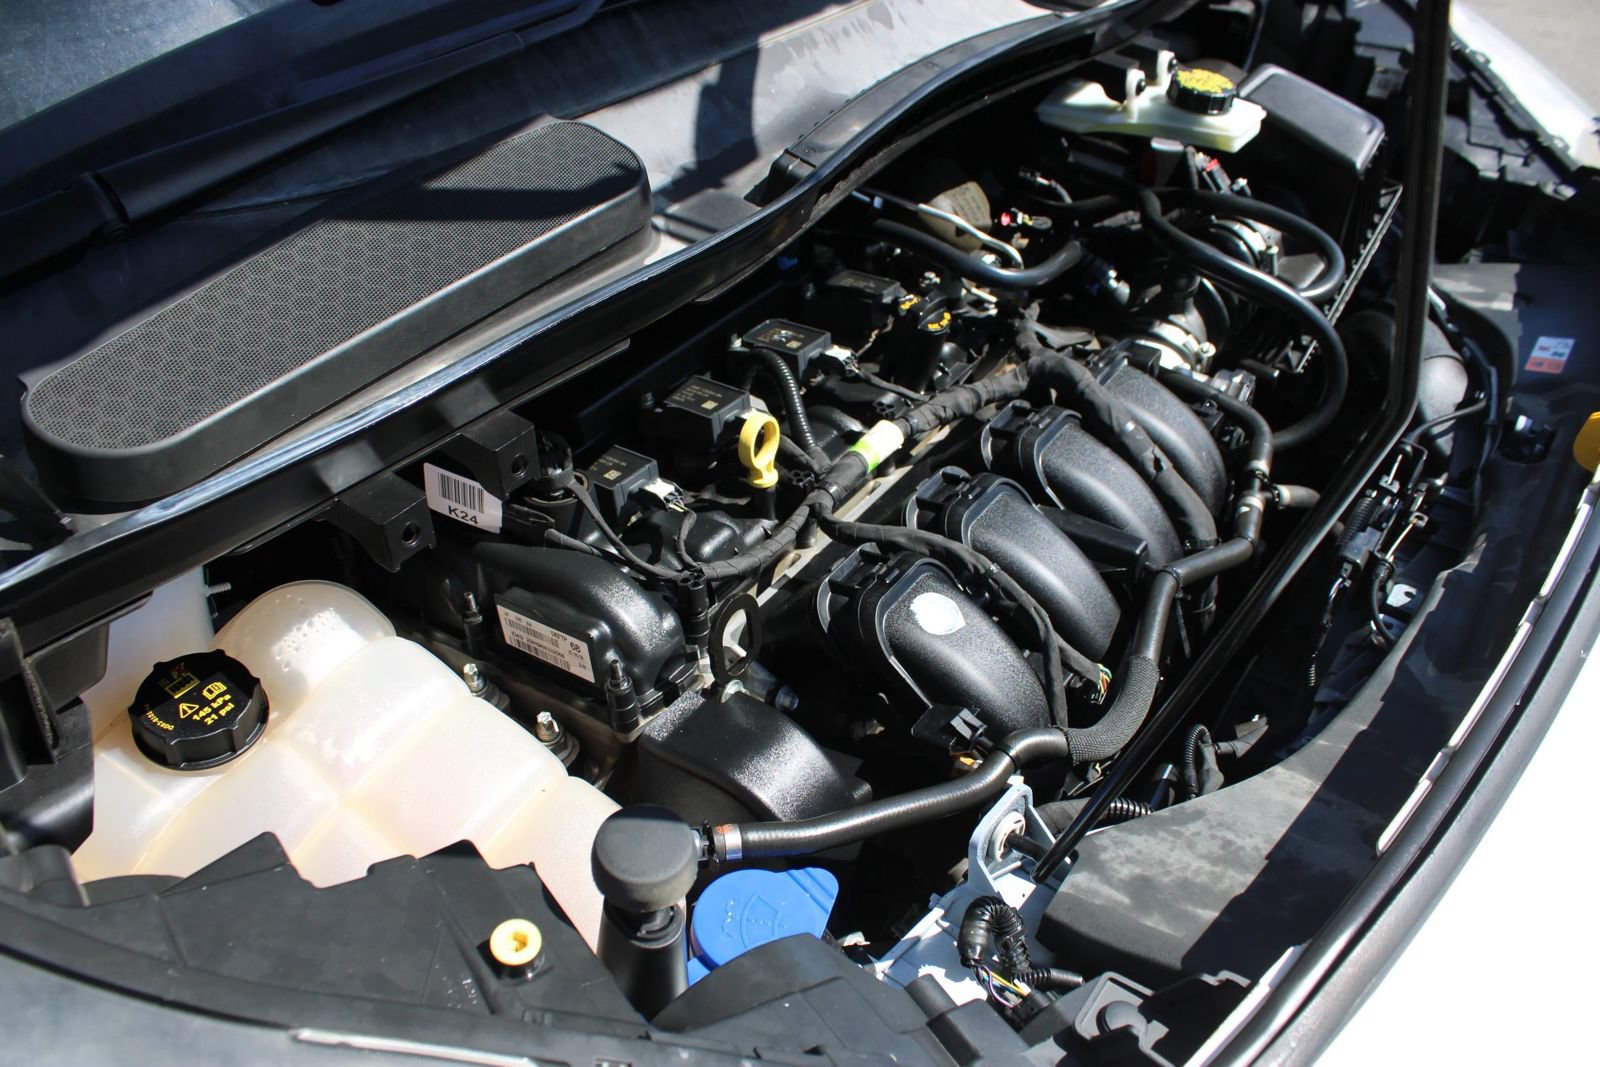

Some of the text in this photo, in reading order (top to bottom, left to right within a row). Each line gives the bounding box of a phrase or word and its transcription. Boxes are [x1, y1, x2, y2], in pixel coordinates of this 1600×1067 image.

[447, 505, 479, 525] K24
[192, 694, 232, 721] 145 kPa
[204, 714, 219, 725] 21
